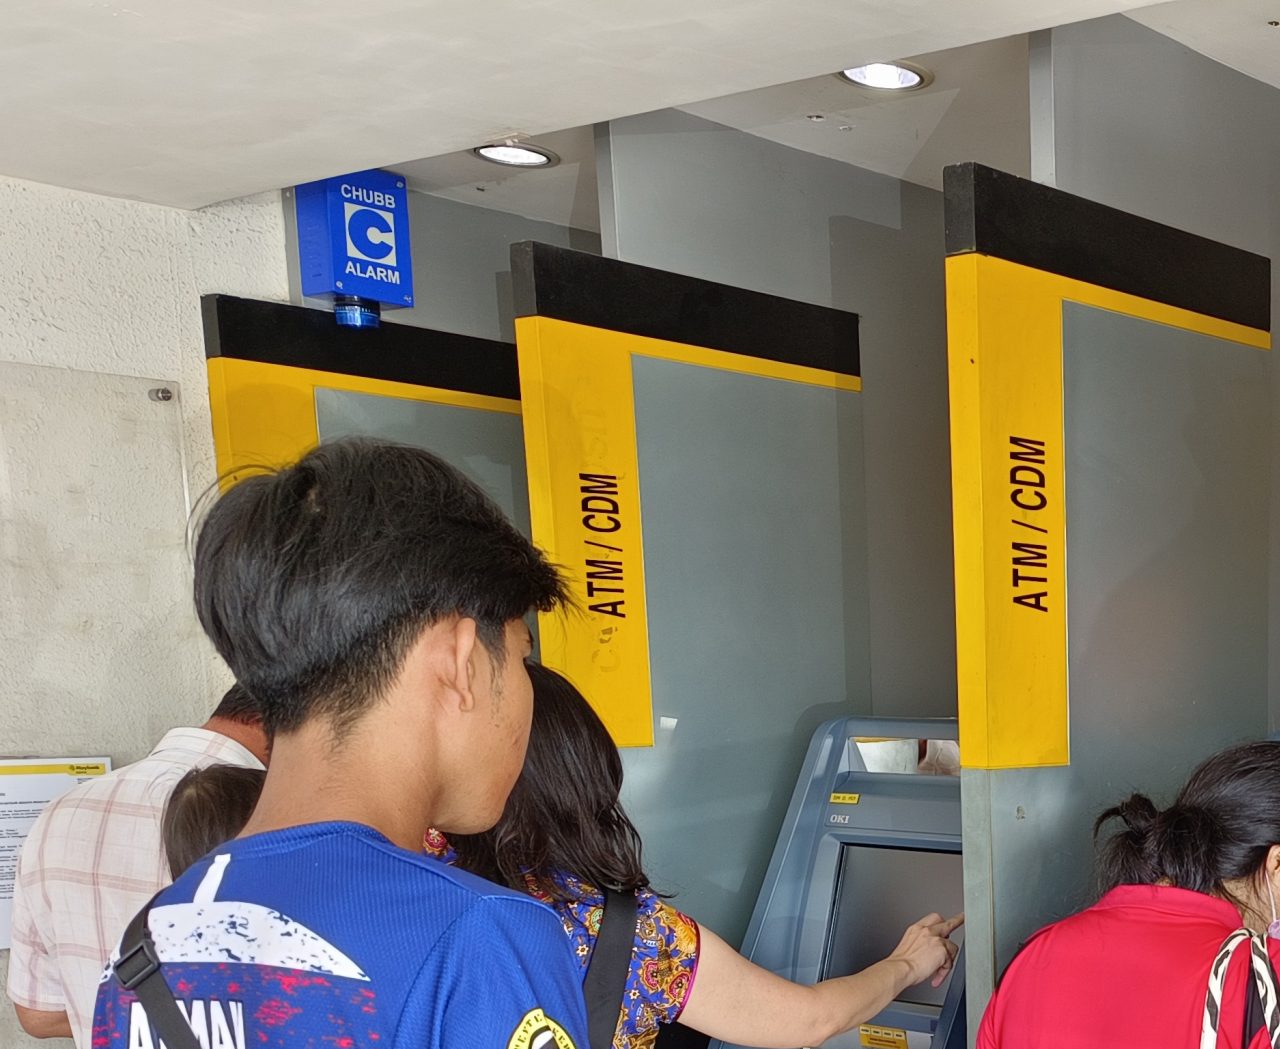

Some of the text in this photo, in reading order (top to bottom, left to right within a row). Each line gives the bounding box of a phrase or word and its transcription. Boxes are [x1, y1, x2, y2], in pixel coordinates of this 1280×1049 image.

[341, 184, 396, 209] CHUBB
[348, 208, 394, 260] C
[345, 261, 400, 285] ALARM
[578, 472, 622, 533] CDM
[1009, 435, 1048, 613] ATM / CDM
[584, 540, 624, 553] /
[585, 559, 626, 618] ATM
[830, 814, 850, 824] OKI
